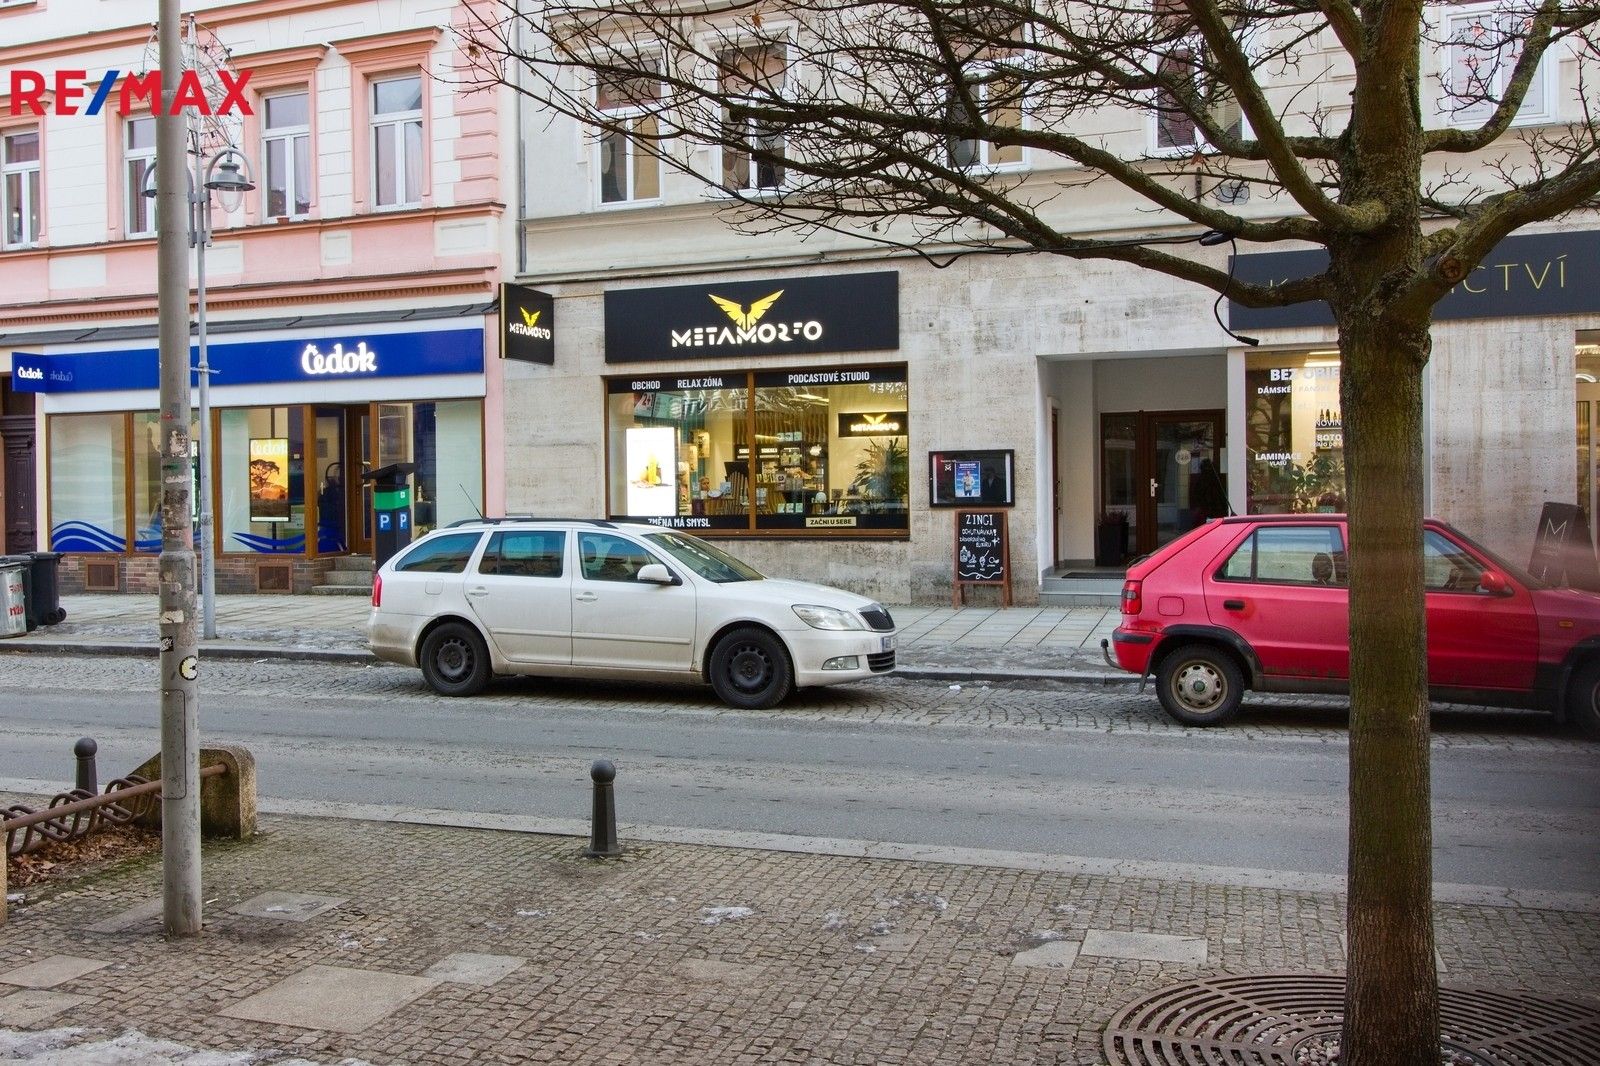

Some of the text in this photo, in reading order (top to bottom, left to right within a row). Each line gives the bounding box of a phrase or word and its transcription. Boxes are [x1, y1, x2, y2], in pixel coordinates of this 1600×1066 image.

[509, 322, 551, 340] METAMORFO
[671, 320, 823, 347] METAMORFO
[301, 341, 378, 375] Čedok
[788, 371, 870, 384] PODCASTOVÉ STUDIO
[1270, 368, 1298, 381] BEZ
[631, 381, 661, 390] OBCHOD
[677, 376, 723, 389] RELAX ZÓNA
[1257, 385, 1292, 395] DÁMSKÉ
[1317, 433, 1342, 442] BOTO
[380, 514, 390, 529] P
[400, 513, 408, 528] P
[673, 516, 685, 527] MÁ
[686, 517, 711, 528] SMYSL
